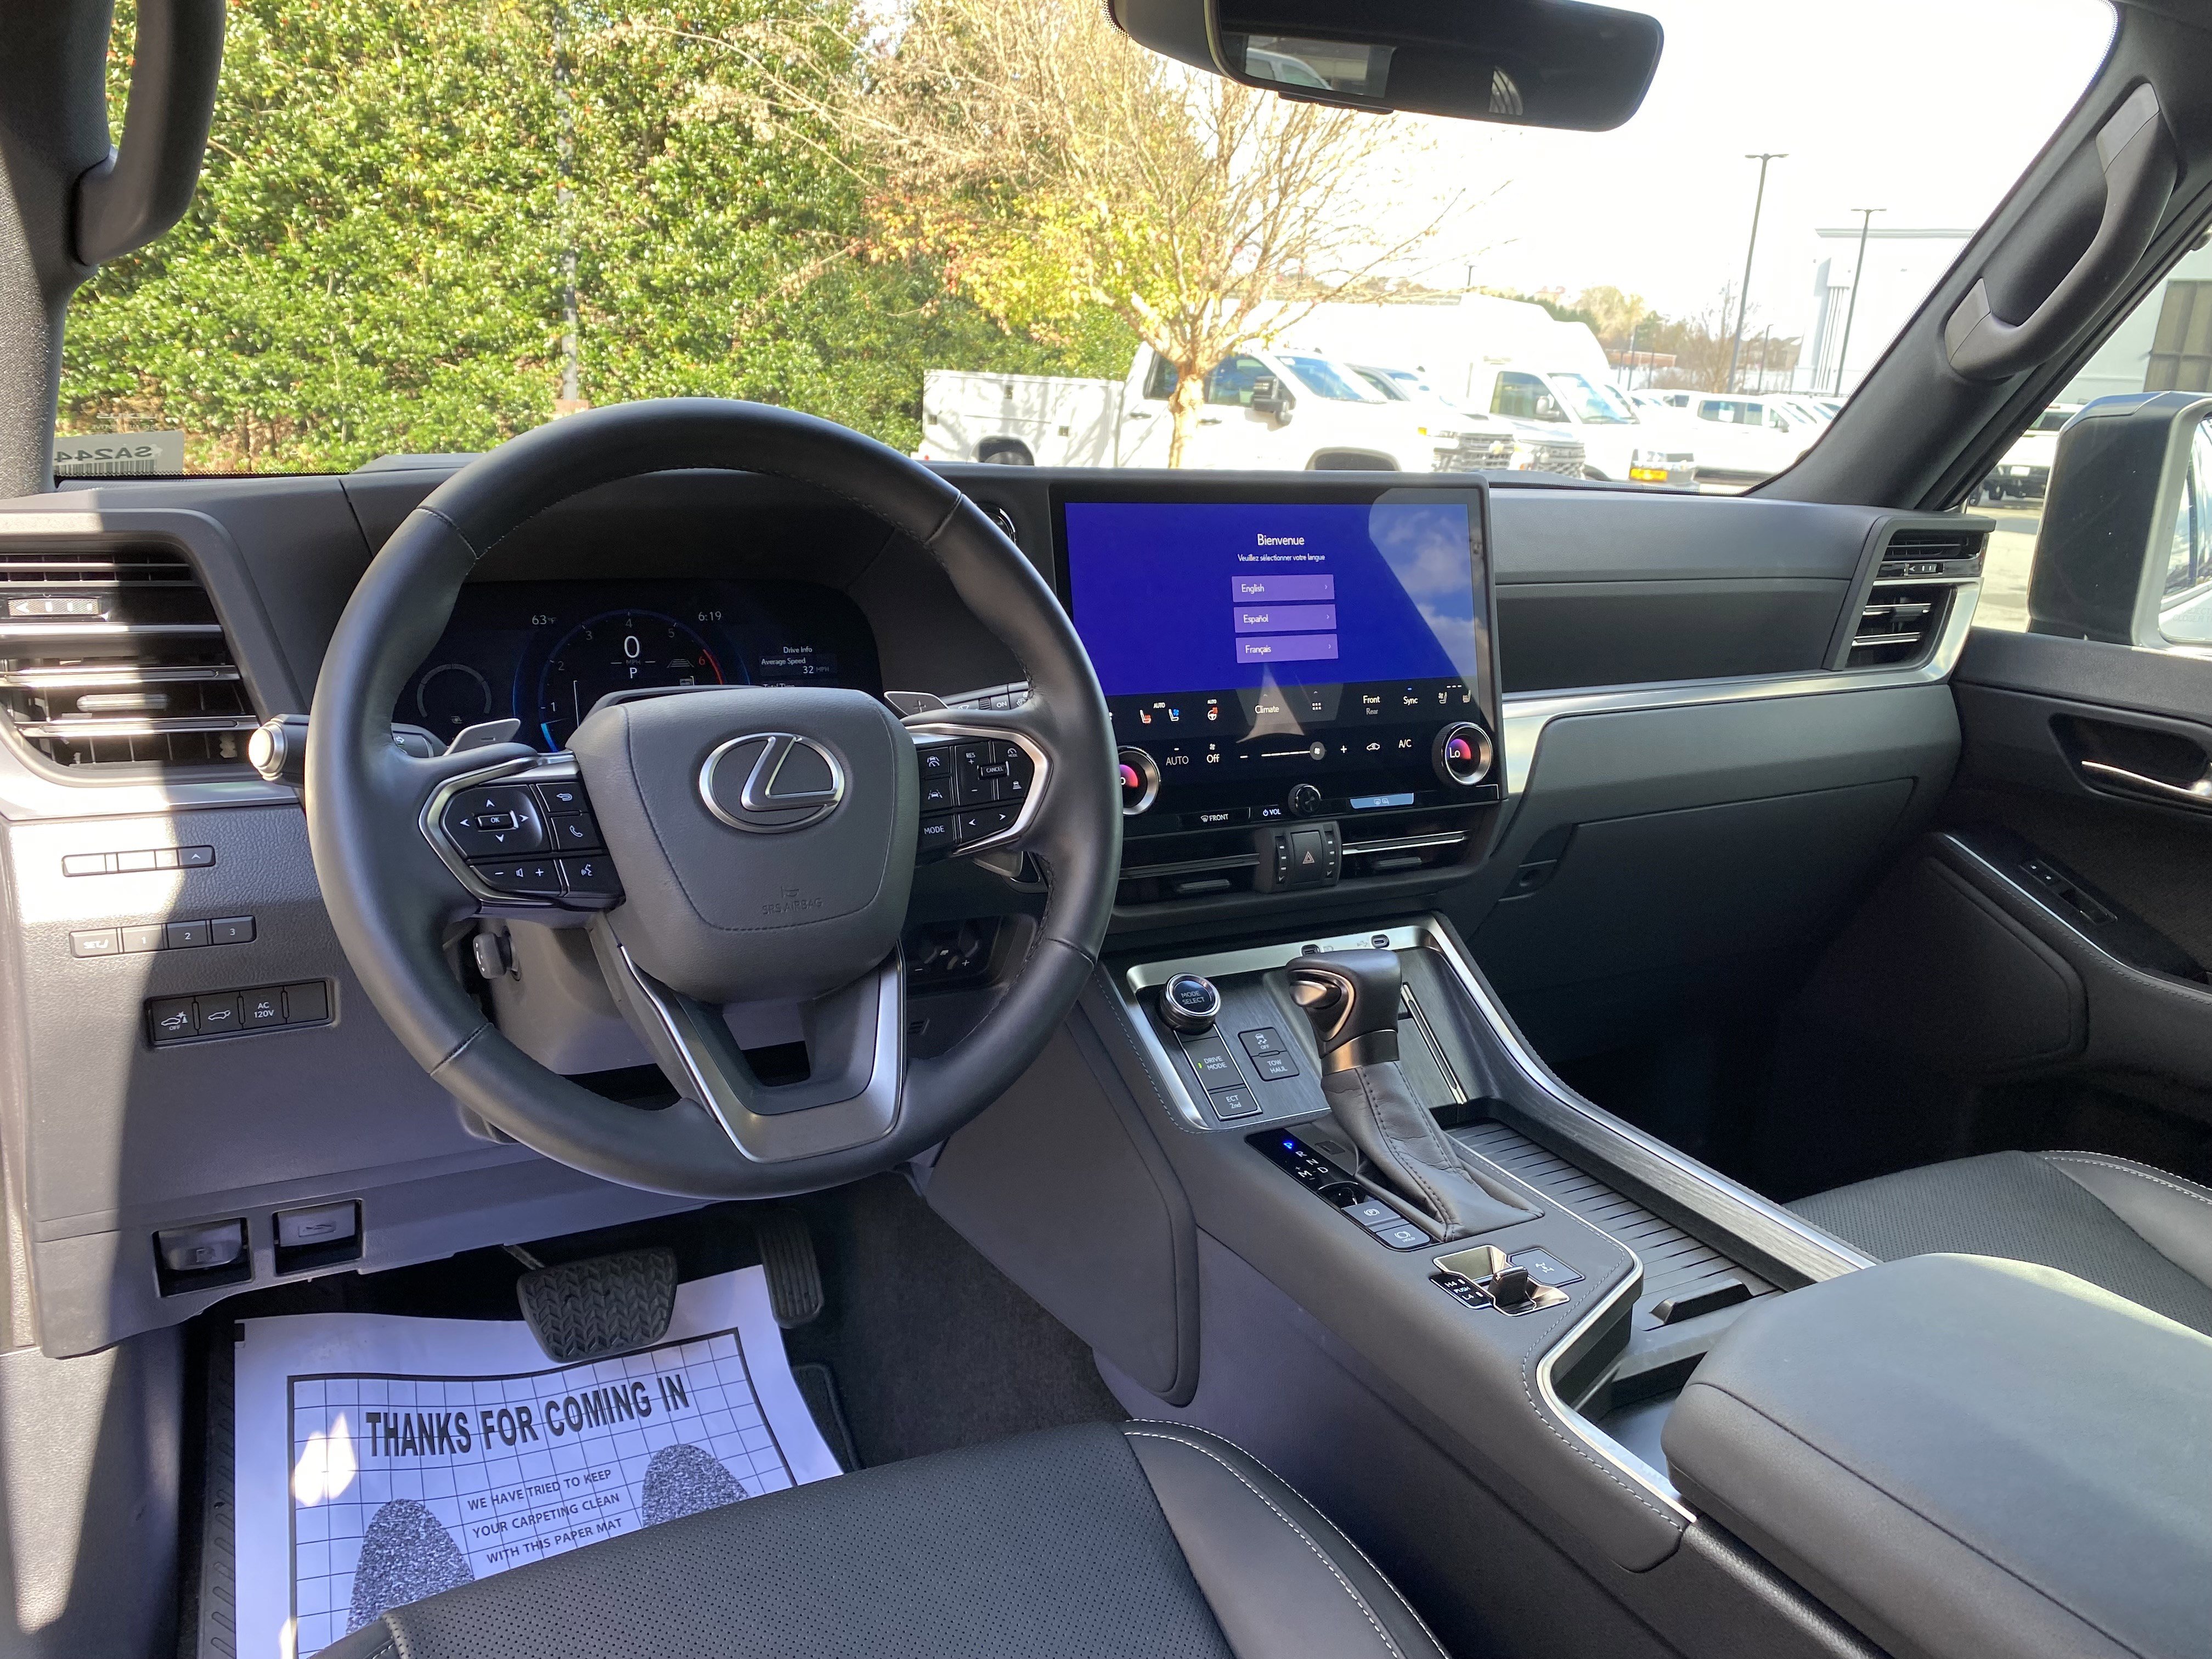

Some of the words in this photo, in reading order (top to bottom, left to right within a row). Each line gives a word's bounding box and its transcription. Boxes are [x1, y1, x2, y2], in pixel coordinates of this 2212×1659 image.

[1257, 533, 1305, 546] Bienvenue
[1238, 554, 1259, 562] Veuillez
[1307, 552, 1325, 562] langue
[1242, 583, 1265, 594] English
[698, 611, 722, 622] 6:19
[1243, 614, 1269, 624] Español
[625, 618, 633, 628] 4
[585, 630, 592, 640] 3
[668, 628, 675, 638] 5
[1245, 645, 1272, 655] Français
[558, 661, 565, 671] 2
[699, 657, 706, 665] 6
[787, 657, 806, 665] Speed
[630, 667, 637, 679] P
[803, 665, 814, 674] 32
[1363, 695, 1380, 703] Front
[1403, 696, 1418, 706] Sync
[551, 702, 556, 712] 1
[1255, 704, 1279, 714] Climate
[1398, 739, 1412, 748] A/C
[1449, 747, 1460, 758] Lo
[1166, 755, 1189, 765] AUTO
[1207, 754, 1220, 763] Off
[924, 826, 945, 834] MODE
[184, 932, 191, 940] 2
[1180, 990, 1201, 998] MODE
[1182, 996, 1205, 1005] SELECT
[254, 1009, 274, 1018] 120V
[1204, 1056, 1223, 1064] DRIVE
[1207, 1062, 1227, 1070] MODE
[1270, 1065, 1288, 1073] HAUL
[1226, 1094, 1239, 1103] ECT
[365, 1412, 471, 1457] THANKS
[479, 1406, 539, 1450] FOR
[545, 1381, 652, 1436] COMING
[656, 1374, 689, 1412] IN
[467, 1497, 487, 1511] WE
[492, 1489, 524, 1505] HAVE
[526, 1481, 561, 1497] TRIED
[563, 1476, 580, 1488] TO
[583, 1469, 611, 1482] KEEP
[472, 1521, 507, 1539] YOUR
[511, 1504, 579, 1528] CARPETING
[582, 1493, 620, 1510] CLEAN
[486, 1546, 520, 1564] WITH
[522, 1538, 551, 1553] THIS
[554, 1526, 594, 1545] PAPER
[596, 1518, 622, 1533] MAT
